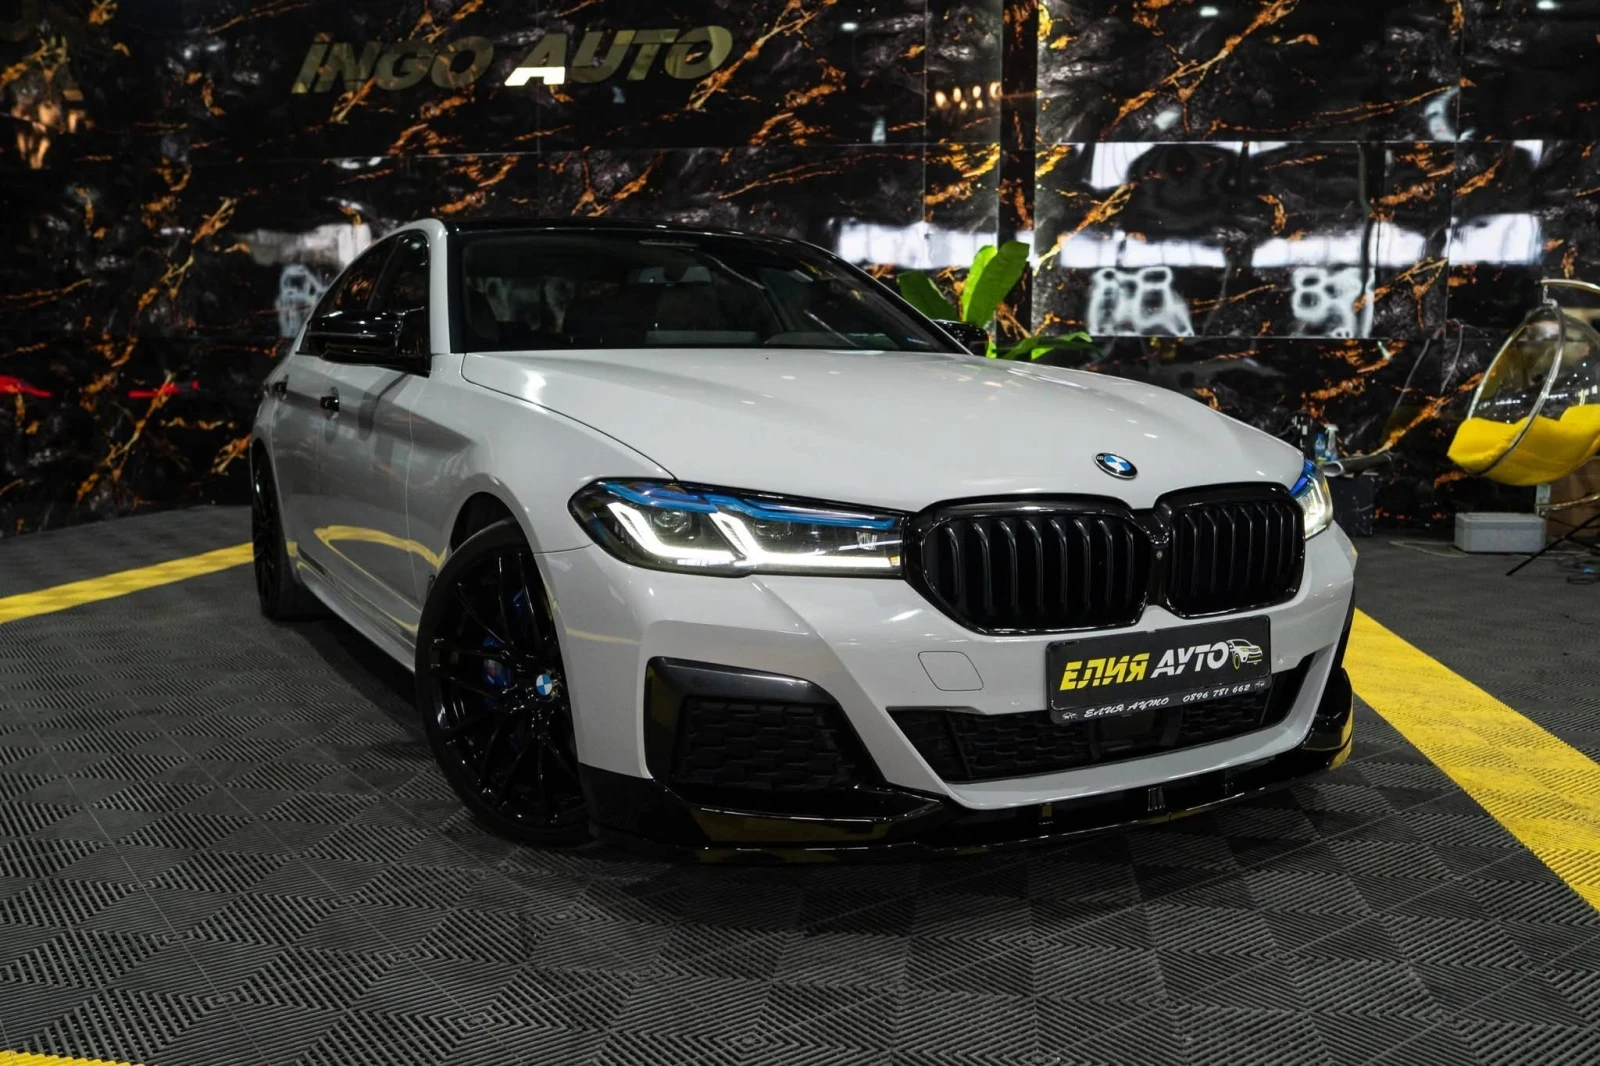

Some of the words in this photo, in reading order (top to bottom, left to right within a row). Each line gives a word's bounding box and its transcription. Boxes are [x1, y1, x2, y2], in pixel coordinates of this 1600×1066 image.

[291, 35, 495, 94] INGO
[504, 25, 734, 87] AUTO
[1059, 652, 1151, 691] ЕЛИЯ
[1150, 641, 1230, 678] АУТО
[1182, 691, 1209, 703] 0896
[1212, 688, 1229, 698] 781
